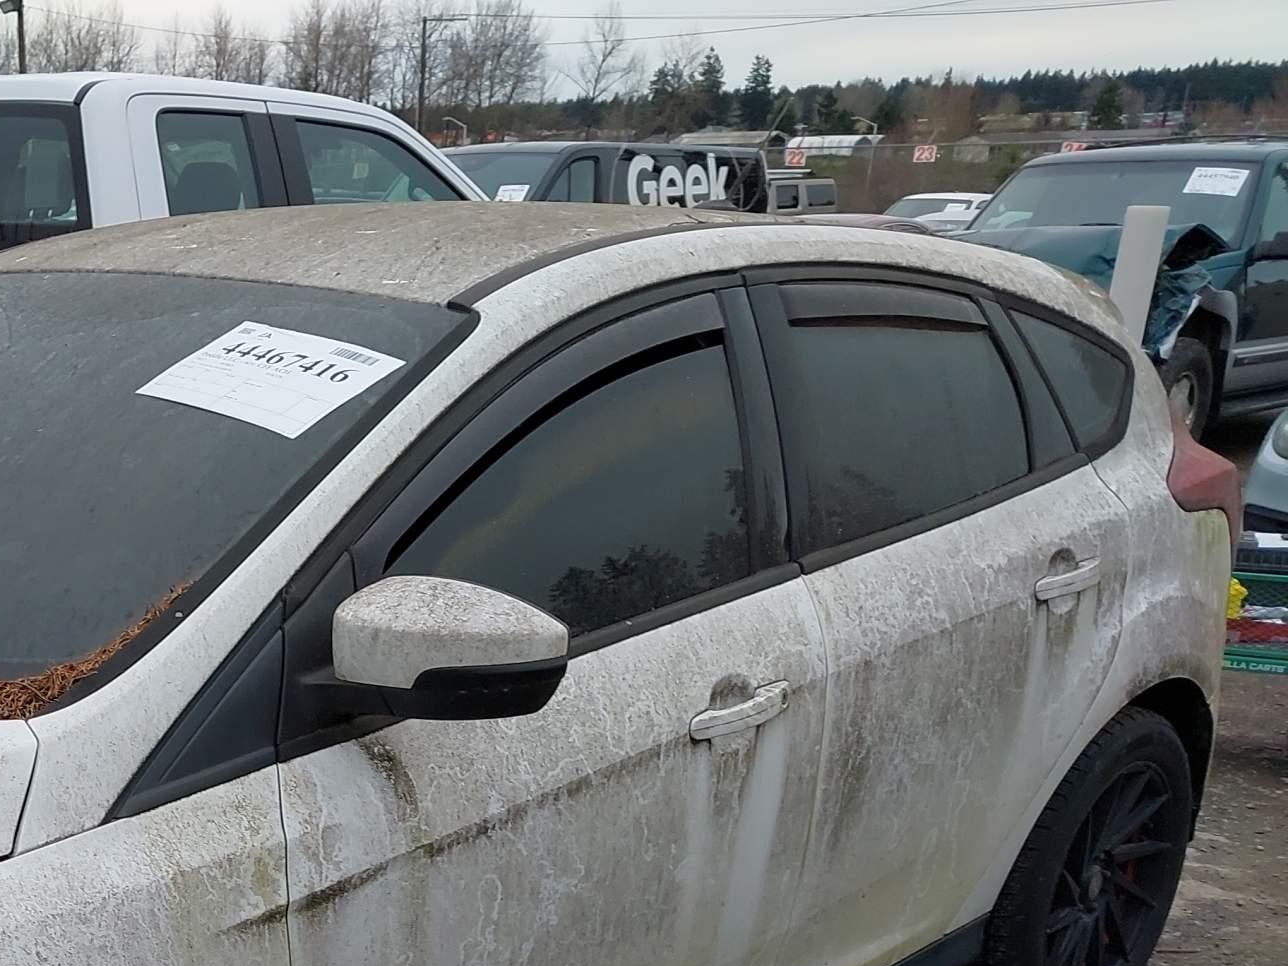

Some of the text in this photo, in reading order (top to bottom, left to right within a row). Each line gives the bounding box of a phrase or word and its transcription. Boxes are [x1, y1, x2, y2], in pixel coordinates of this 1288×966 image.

[787, 151, 804, 165] 22
[915, 146, 934, 161] 23
[627, 153, 729, 208] Geek
[222, 342, 359, 383] 44467416
